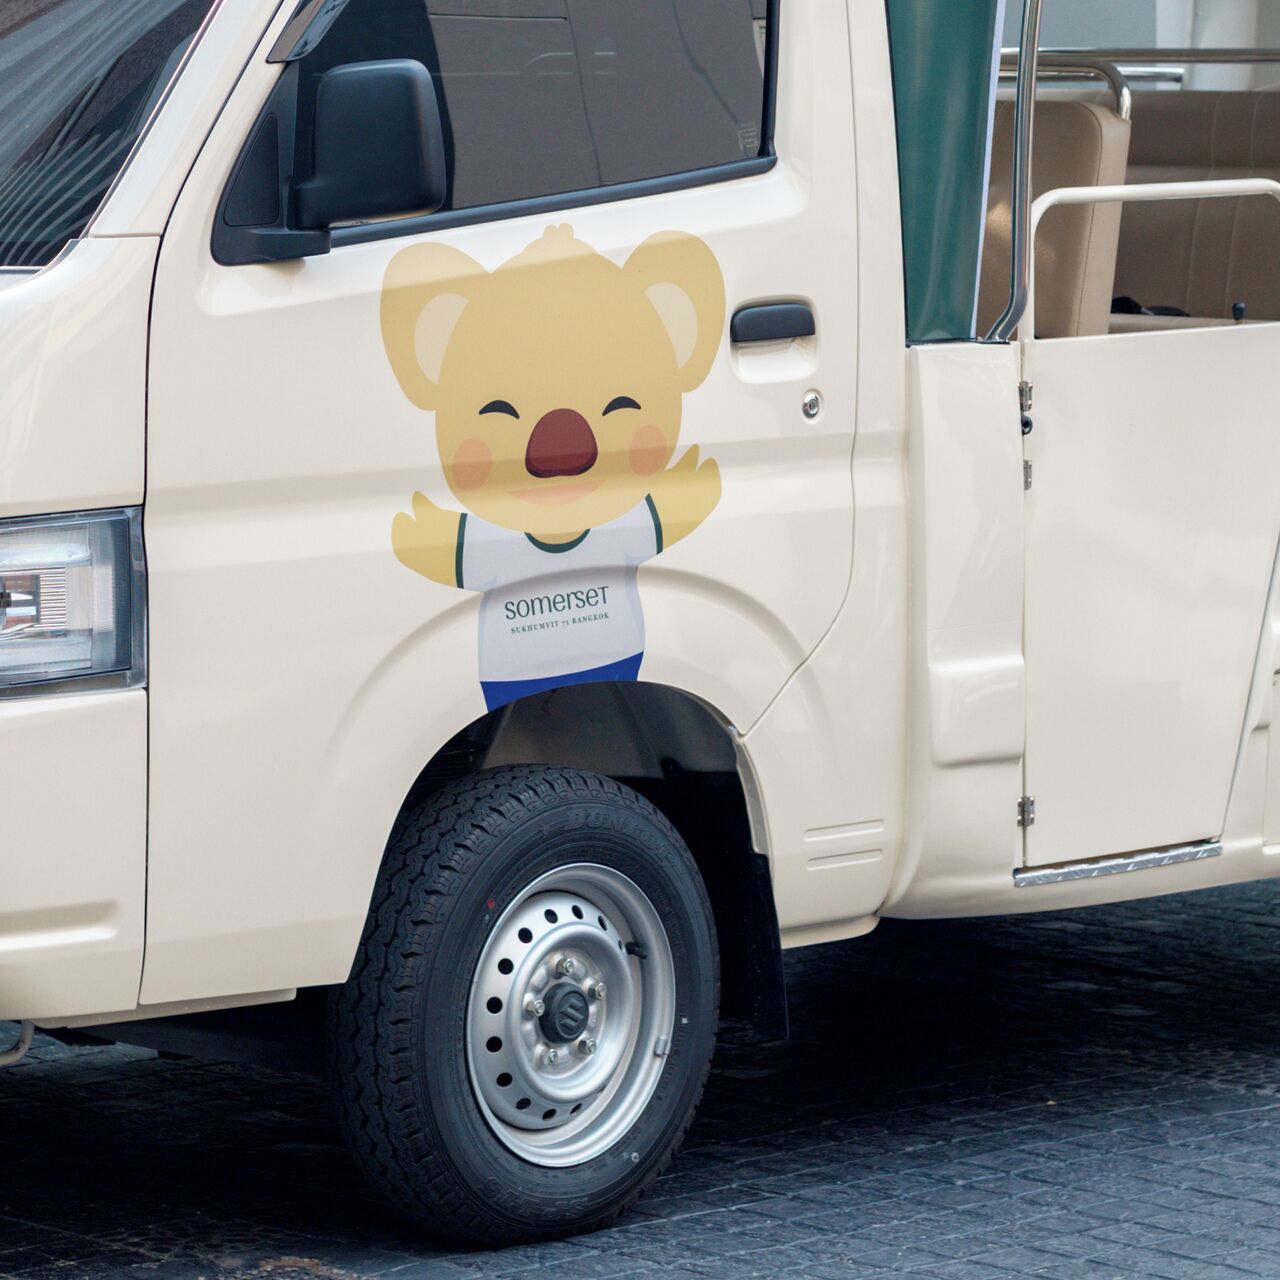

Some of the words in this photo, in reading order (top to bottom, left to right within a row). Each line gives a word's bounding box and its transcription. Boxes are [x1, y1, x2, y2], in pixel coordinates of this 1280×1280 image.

[511, 620, 559, 634] SUKHUMVIT
[562, 620, 570, 628] 71
[572, 611, 610, 625] BANGKOK
